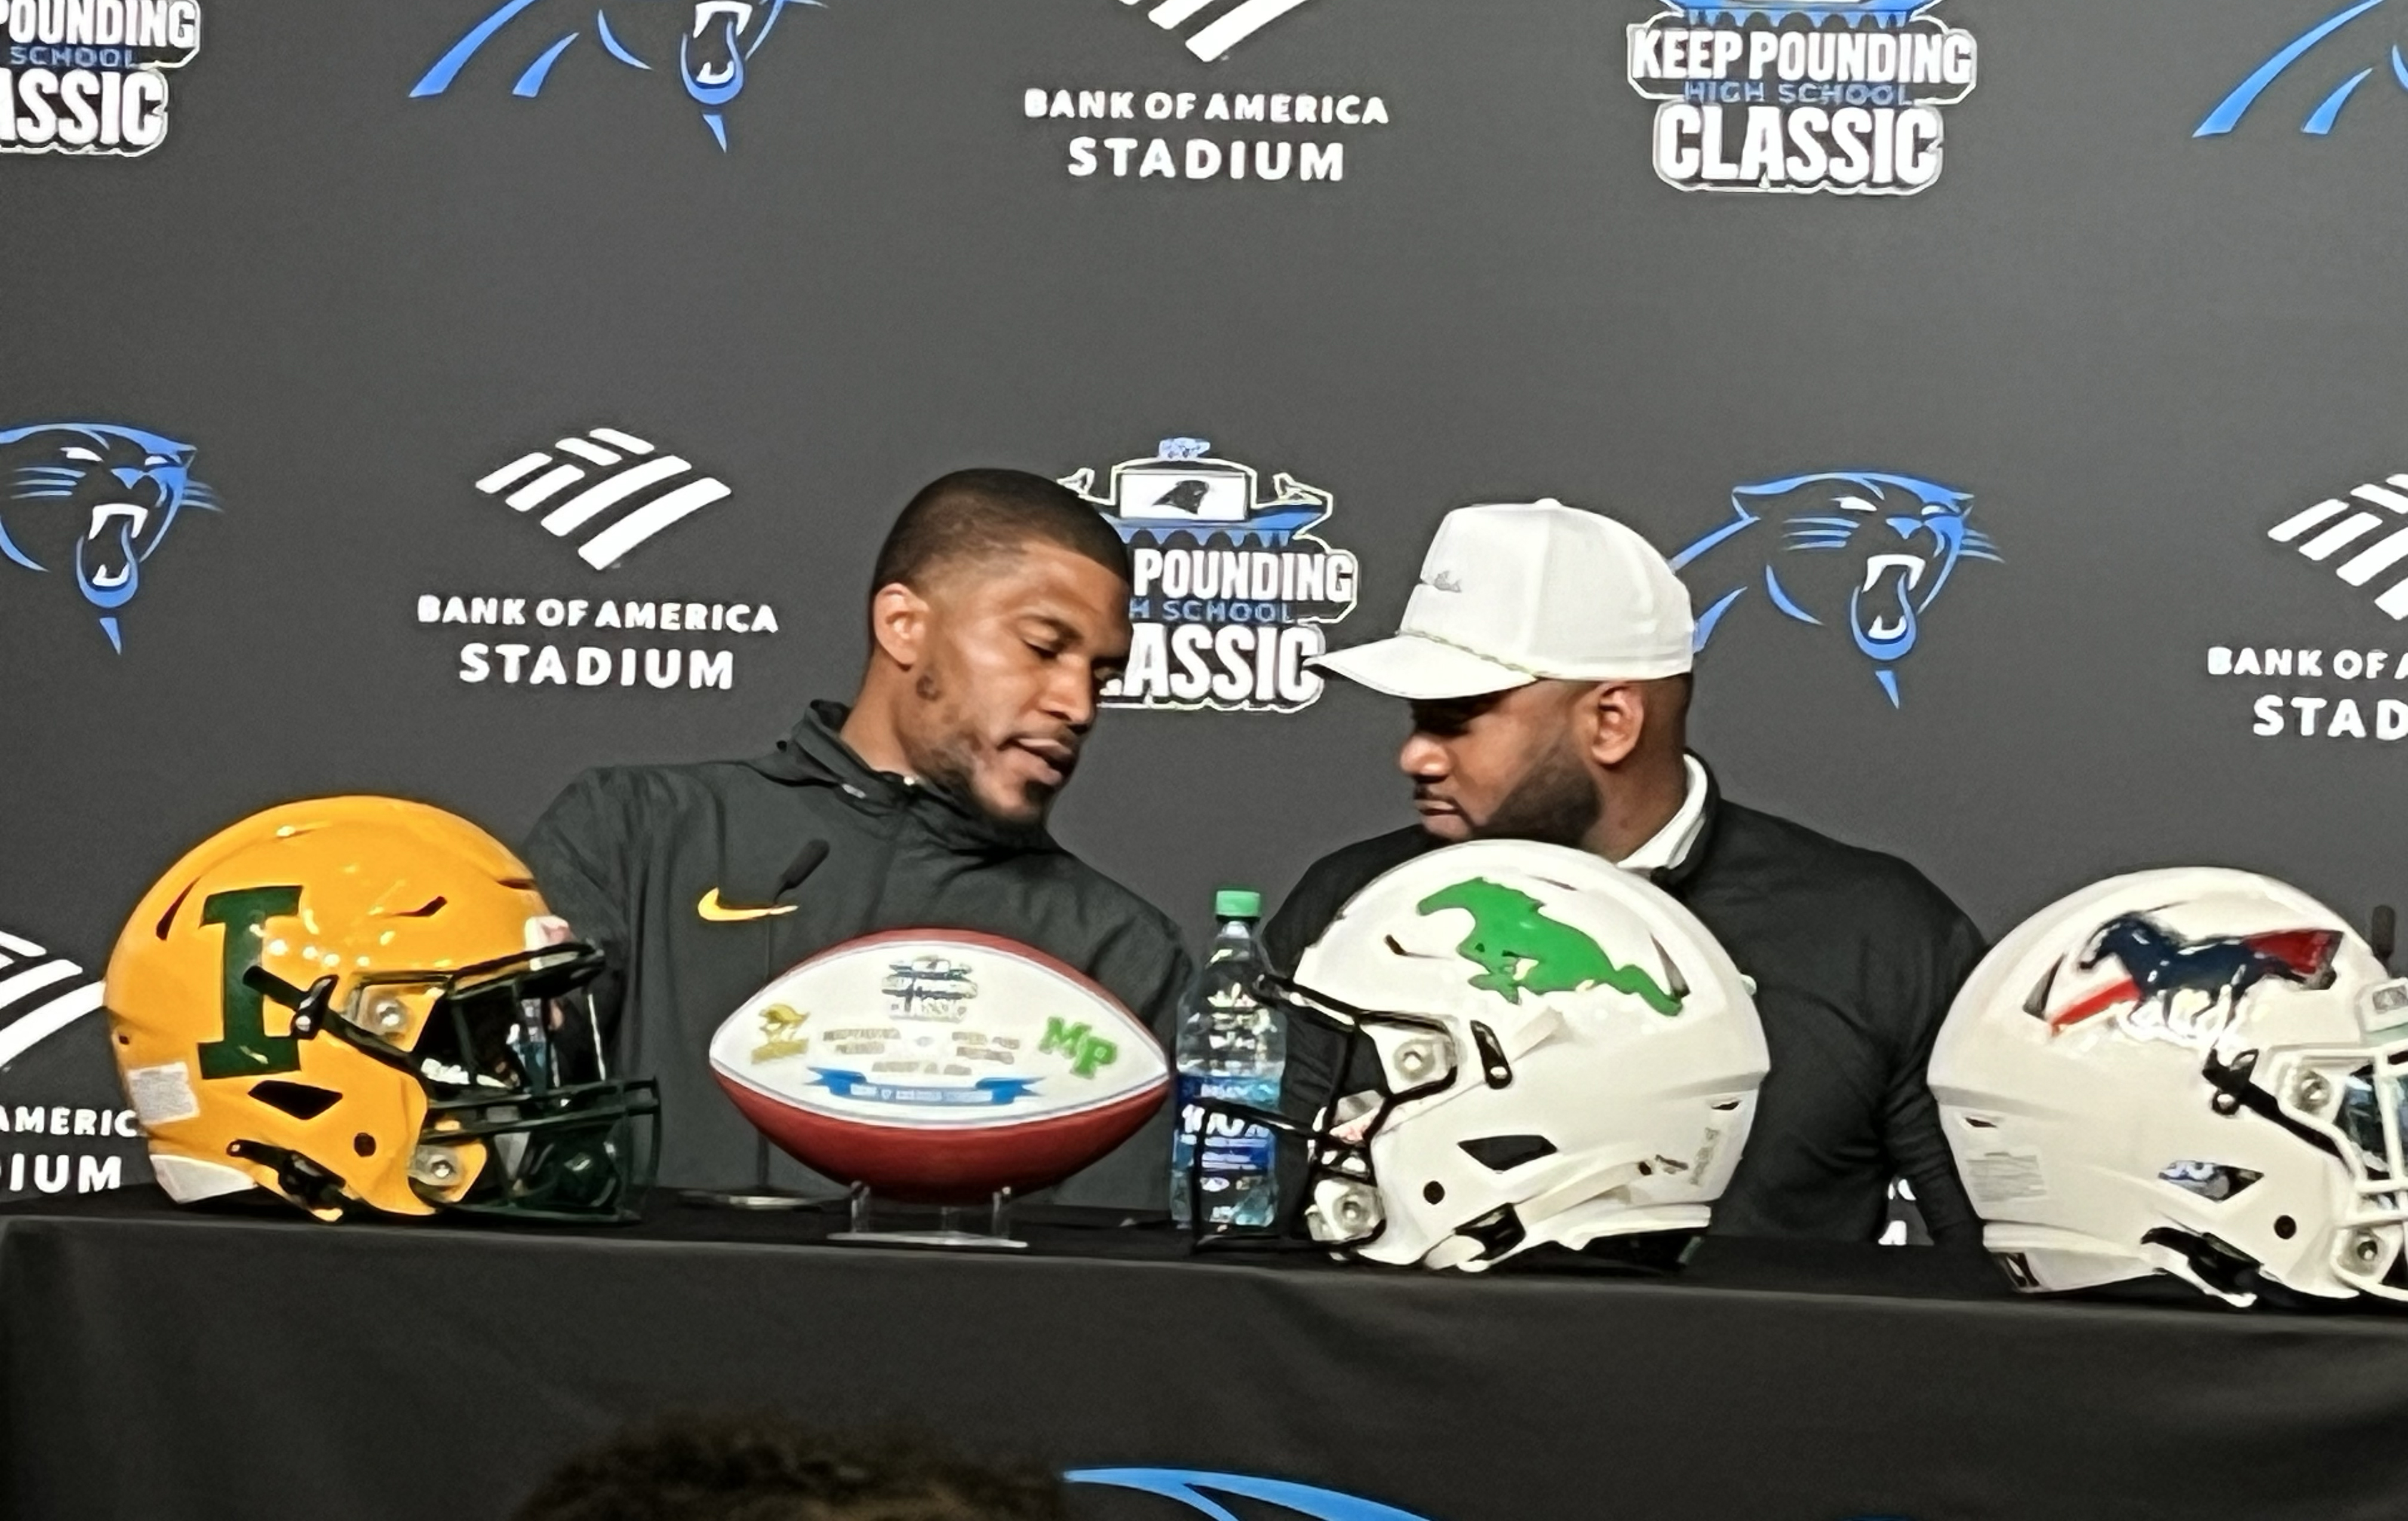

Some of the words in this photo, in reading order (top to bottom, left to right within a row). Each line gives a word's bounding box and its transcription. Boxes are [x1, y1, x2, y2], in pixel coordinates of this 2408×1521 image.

[10, 45, 133, 68] SCHOOL
[1633, 29, 1743, 79] KEEP
[1749, 32, 1973, 84] POUNDING
[1024, 88, 1134, 118] BANK
[1144, 91, 1197, 119] OF
[1204, 93, 1389, 124] AMERICA
[1684, 81, 1765, 103] HIGH
[1778, 82, 1915, 106] SCHOOL
[1068, 136, 1344, 181] STADIUM
[1660, 104, 1939, 184] CLASSIC
[1134, 548, 1353, 602] POUNDING
[417, 594, 526, 625] BANK
[536, 599, 589, 627] OF
[594, 600, 779, 633] AMERICA
[1163, 602, 1297, 624] SCHOOL
[459, 642, 733, 689] STADIUM
[1100, 622, 1321, 701] ASSIC
[2207, 646, 2323, 677] BANK
[2333, 649, 2389, 680] OF
[1039, 1016, 1118, 1080] MP
